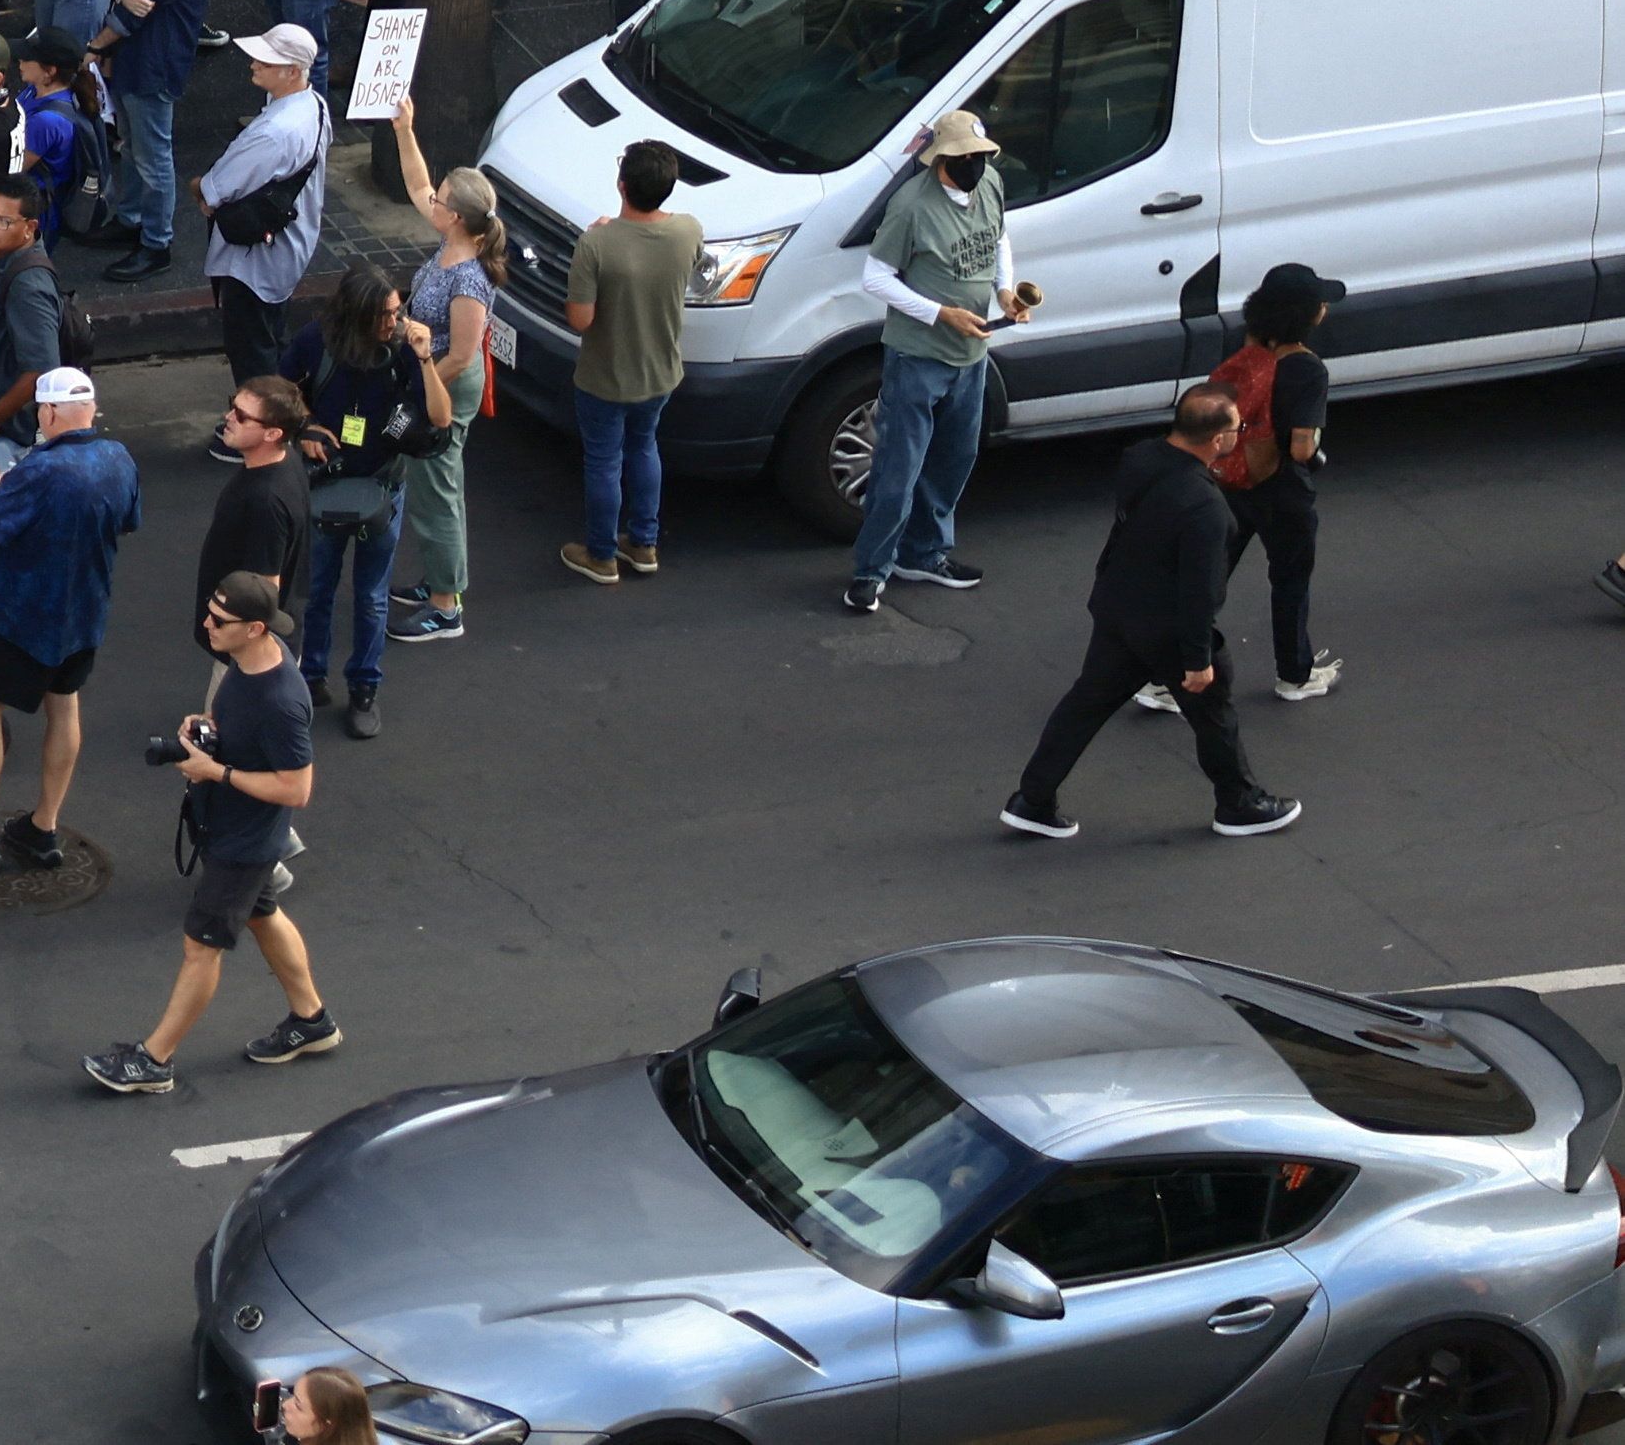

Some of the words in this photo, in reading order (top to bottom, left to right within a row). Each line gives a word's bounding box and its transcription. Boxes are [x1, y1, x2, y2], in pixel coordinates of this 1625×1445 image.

[368, 14, 424, 42] SHAME
[382, 44, 400, 56] ON
[374, 60, 402, 77] ABC
[355, 81, 410, 107] DISNEY
